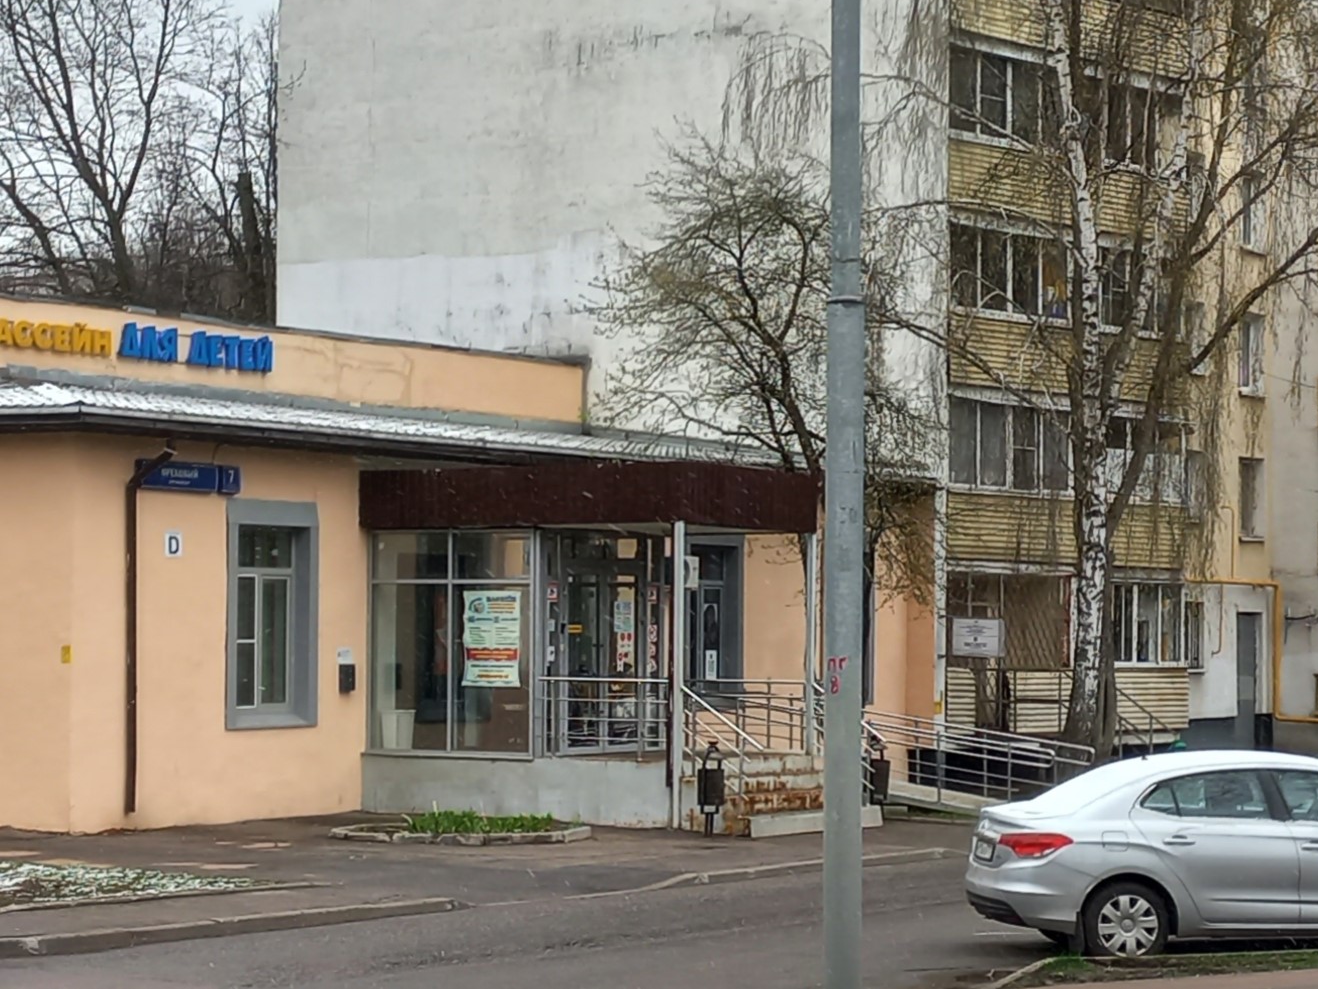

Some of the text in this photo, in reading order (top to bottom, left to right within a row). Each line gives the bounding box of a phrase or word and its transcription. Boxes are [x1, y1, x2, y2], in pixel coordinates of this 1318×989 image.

[117, 322, 178, 362] ДЛЯ
[188, 331, 273, 373] ДЕТЕЙ
[227, 469, 235, 484] 7
[168, 535, 180, 555] D
